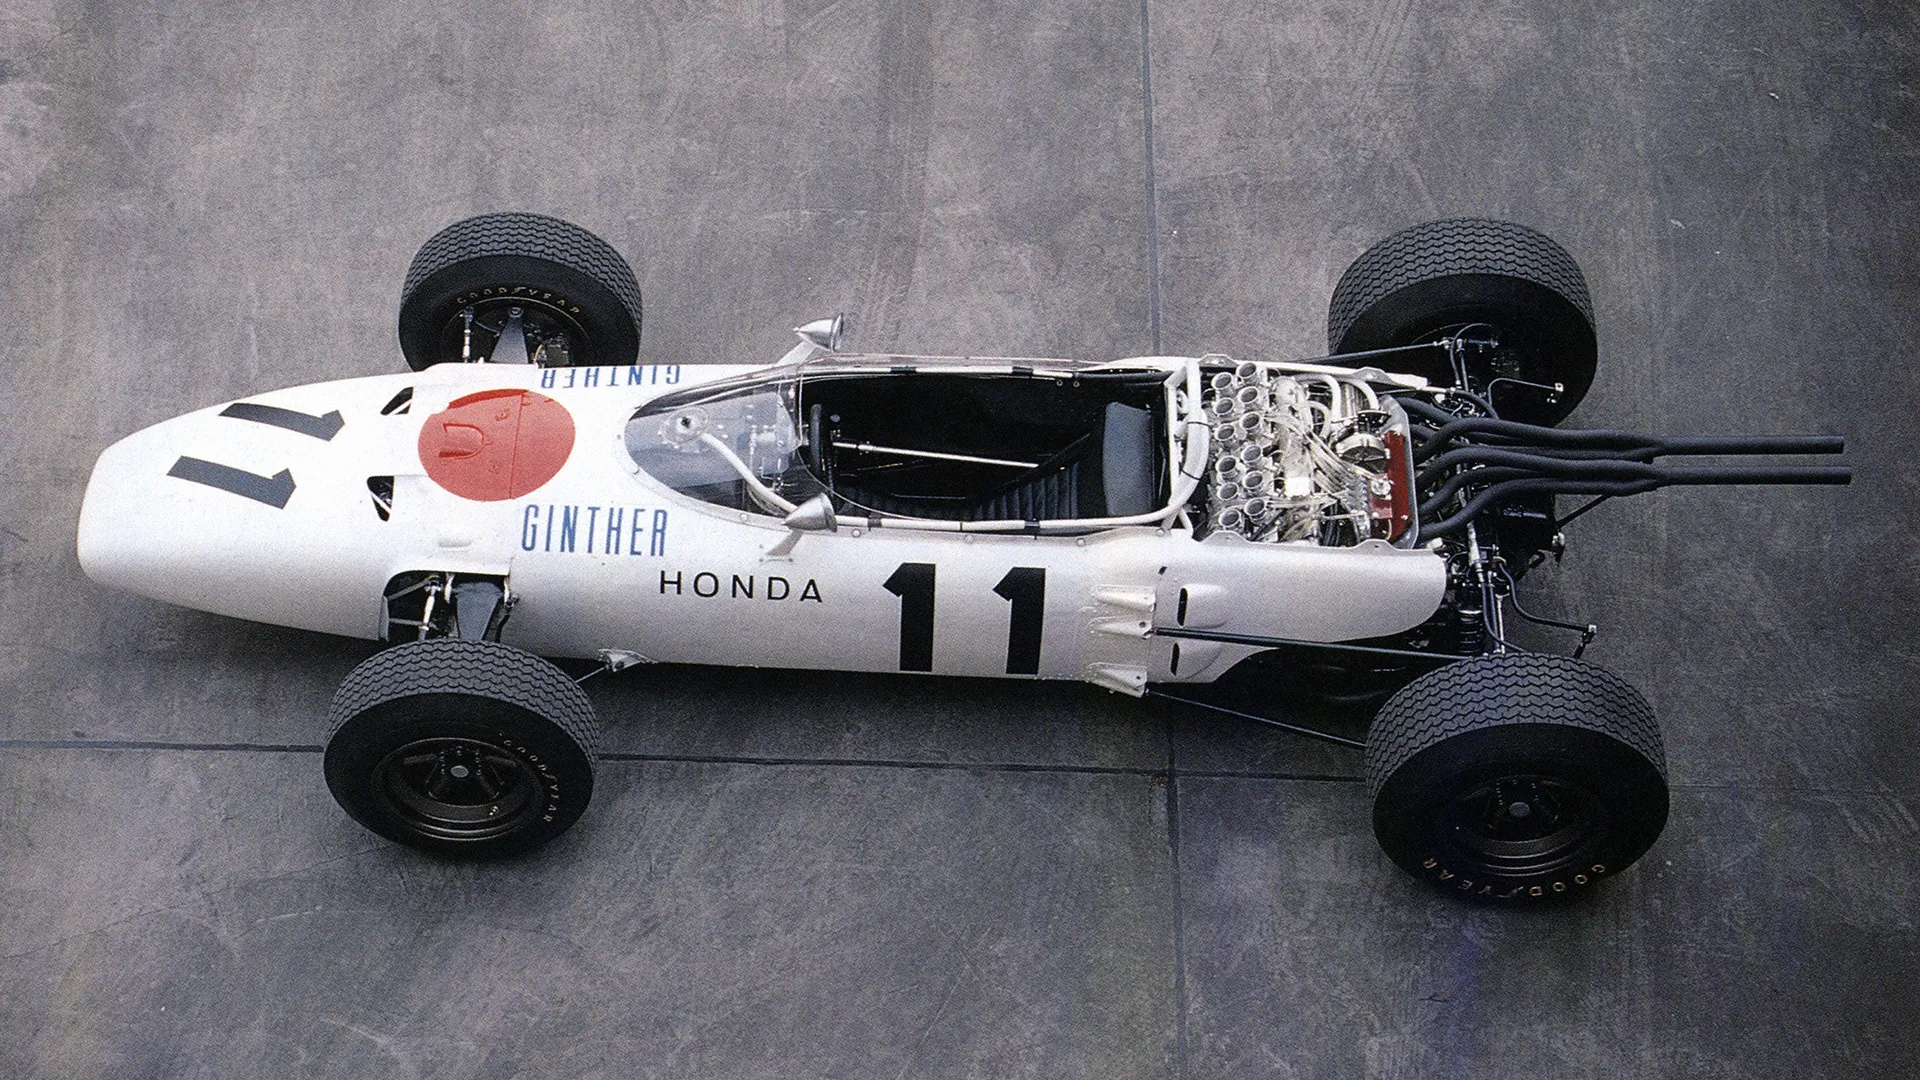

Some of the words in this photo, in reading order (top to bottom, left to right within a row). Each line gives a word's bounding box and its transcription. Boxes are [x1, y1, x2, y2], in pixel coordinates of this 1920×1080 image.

[541, 365, 681, 388] GINTHER
[521, 504, 668, 556] GINTHER
[659, 570, 823, 603] HONDA
[883, 562, 1046, 675] 11
[1422, 858, 1606, 898] GOODYEAR
